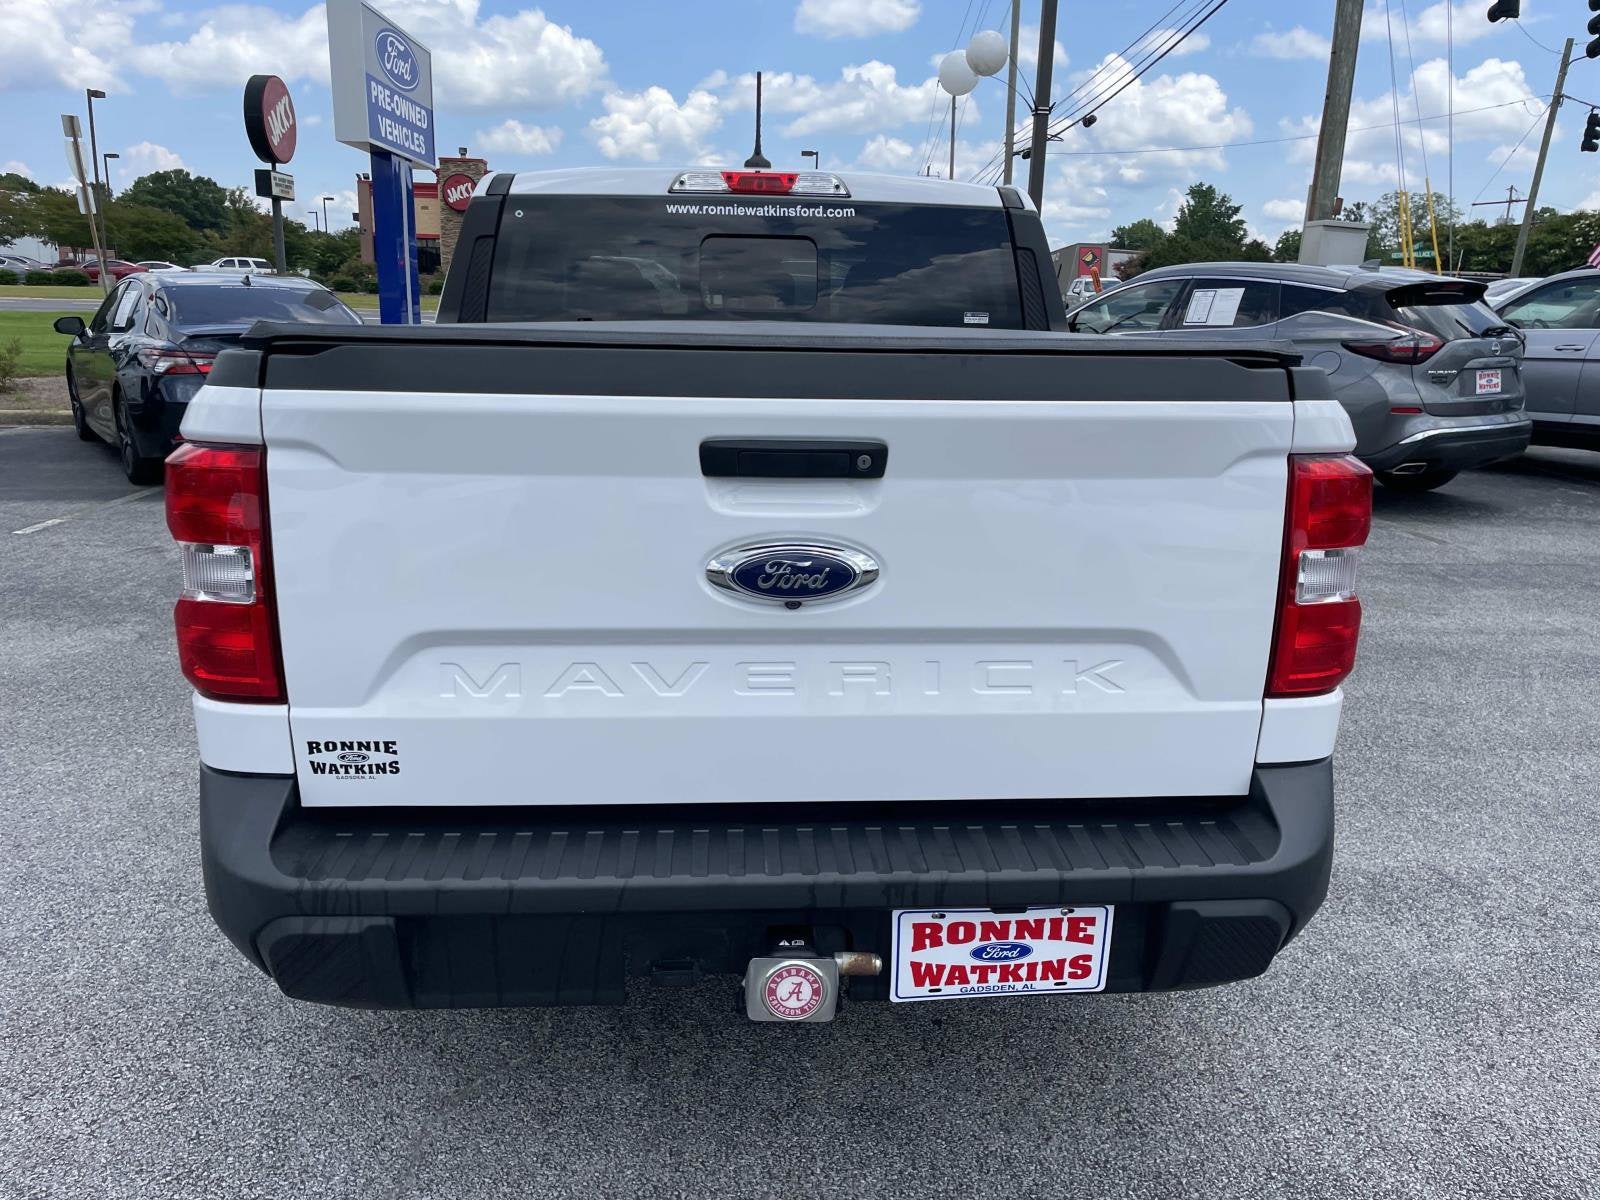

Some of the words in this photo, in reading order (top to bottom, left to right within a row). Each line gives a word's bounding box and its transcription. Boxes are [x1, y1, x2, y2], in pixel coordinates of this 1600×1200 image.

[384, 37, 412, 82] Ford
[371, 81, 428, 129] PRE-OWNED
[378, 114, 426, 155] VEHICLES
[666, 203, 855, 218] www.ronniewatkinsford.com
[757, 559, 830, 590] Ford
[440, 661, 1126, 698] MAVERICK
[307, 741, 398, 755] RONNIE
[309, 761, 400, 775] WATKINS
[911, 916, 1097, 952] RONNIE
[982, 945, 1020, 959] Ford
[769, 968, 820, 989] ALABAMA
[910, 954, 1093, 988] WATKINS
[960, 984, 1019, 994] GADSDEN,
[1022, 983, 1037, 991] AL
[769, 995, 802, 1016] CRIMSON
[803, 995, 820, 1011] TIDE
